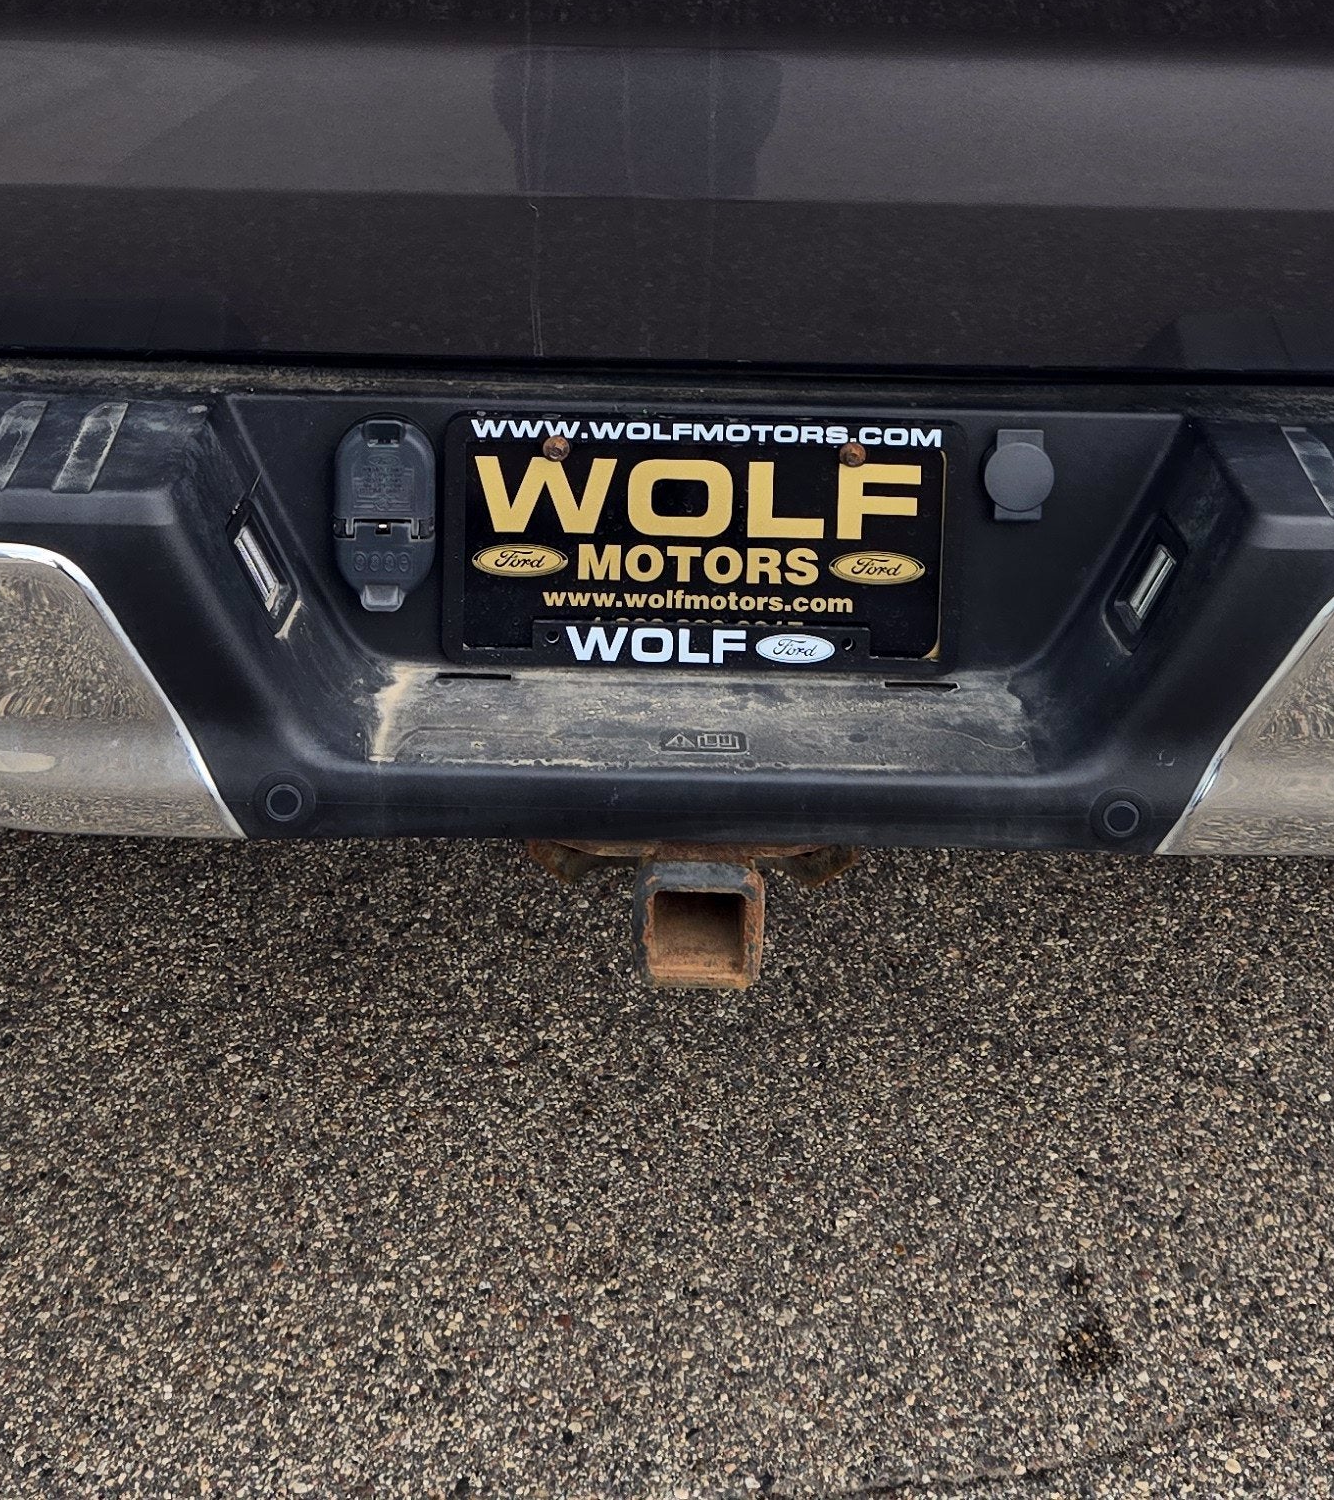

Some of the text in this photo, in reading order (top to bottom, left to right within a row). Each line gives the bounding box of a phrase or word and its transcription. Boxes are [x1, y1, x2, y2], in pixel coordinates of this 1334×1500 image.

[470, 419, 942, 448] WWW.WOLFMOTORS.COM
[474, 456, 922, 540] WOLF
[577, 544, 820, 585] MOTORS
[542, 590, 854, 613] www.wolfmotors.com
[566, 626, 747, 664] WOLF
